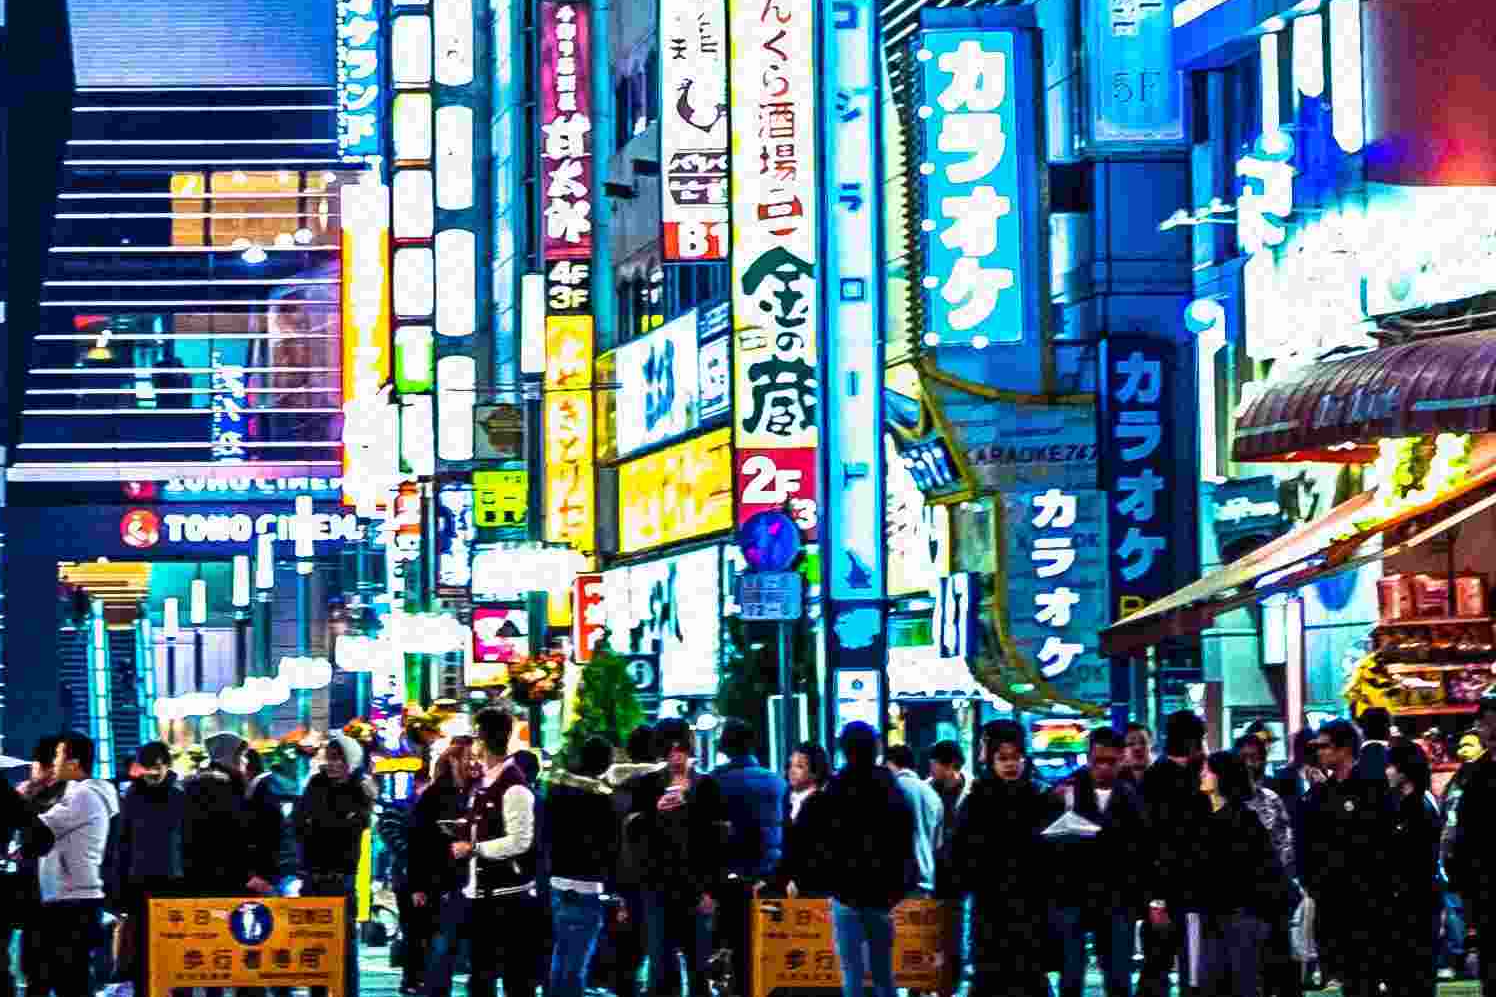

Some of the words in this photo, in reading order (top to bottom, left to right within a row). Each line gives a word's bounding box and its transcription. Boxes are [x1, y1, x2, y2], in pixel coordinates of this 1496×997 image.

[937, 39, 1014, 331] カラオケ
[547, 260, 589, 285] 4F
[548, 285, 589, 310] 3F
[741, 245, 816, 437] 金の蔵
[740, 455, 803, 505] 2F
[1114, 351, 1167, 581] カラオケ
[163, 514, 253, 543] TOHO
[1031, 488, 1085, 678] カラオケ
